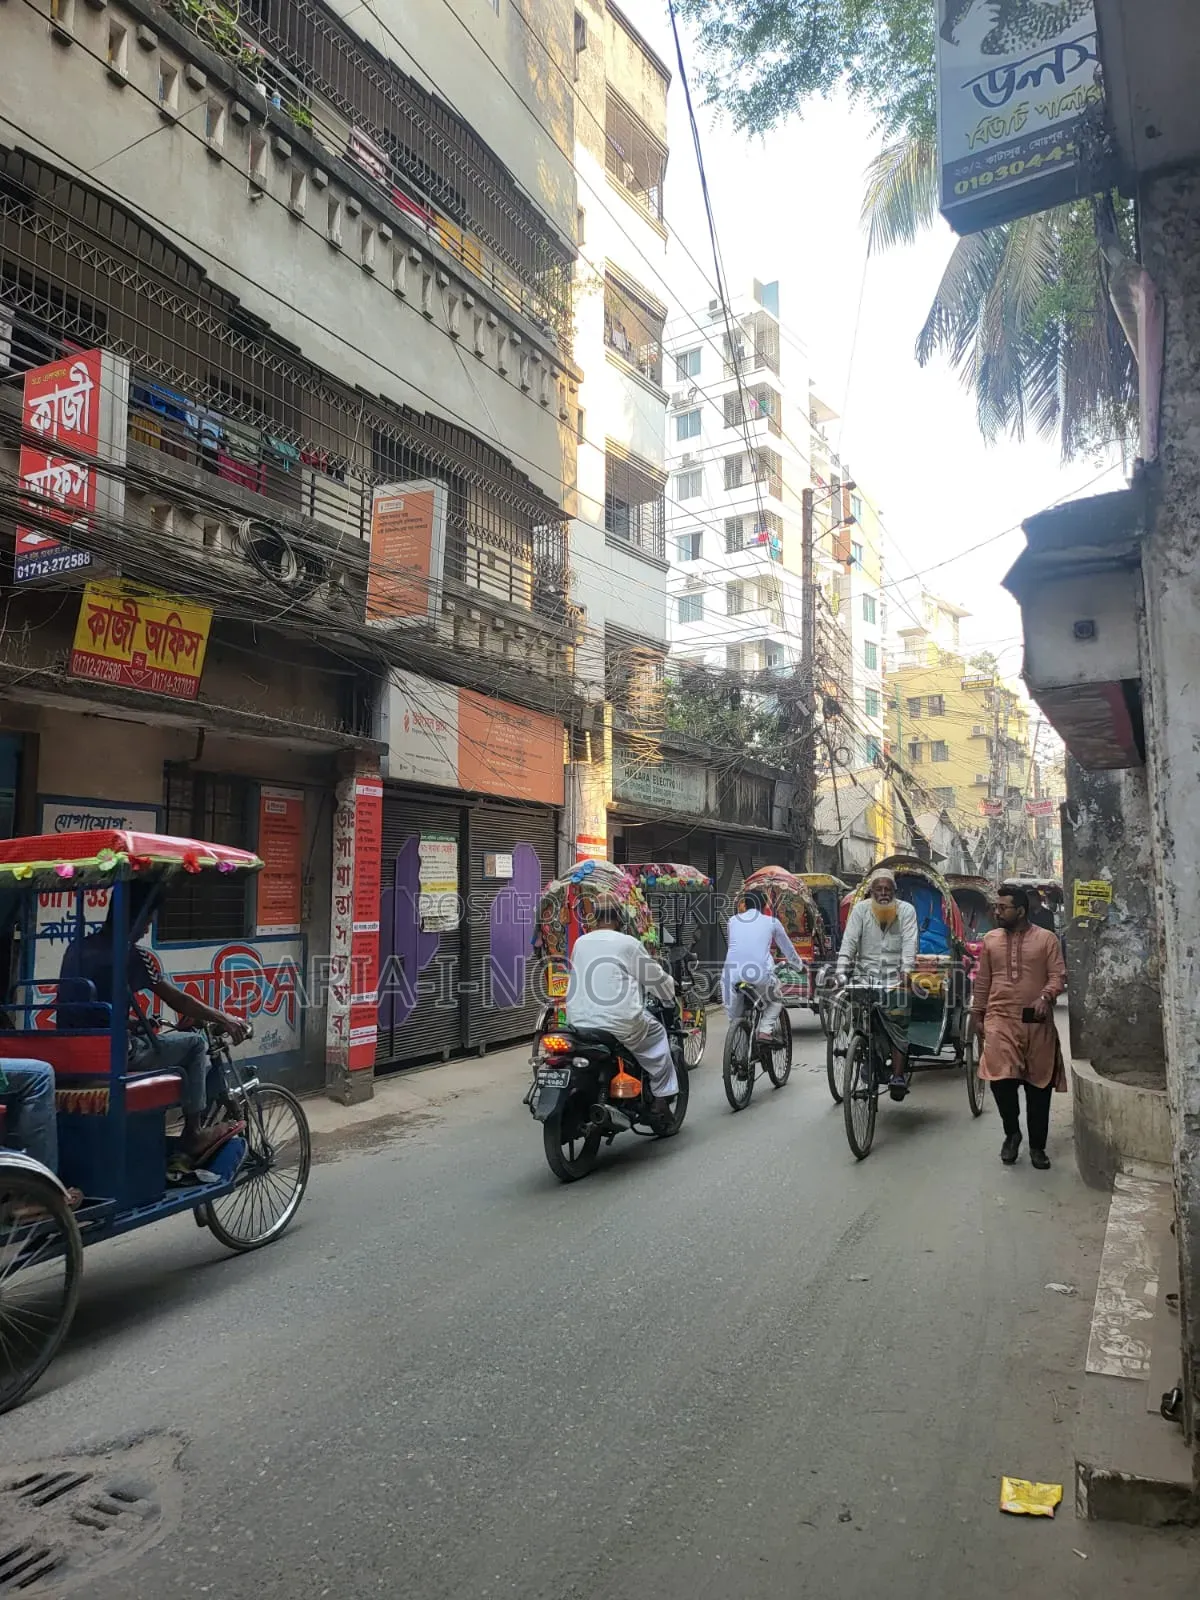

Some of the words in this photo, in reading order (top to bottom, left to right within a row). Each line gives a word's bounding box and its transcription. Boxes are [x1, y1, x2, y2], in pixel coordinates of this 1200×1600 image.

[28, 361, 95, 441] কাজী
[17, 552, 90, 579] 01712-272588
[87, 598, 142, 654] কাজী
[145, 612, 204, 670] অফিস
